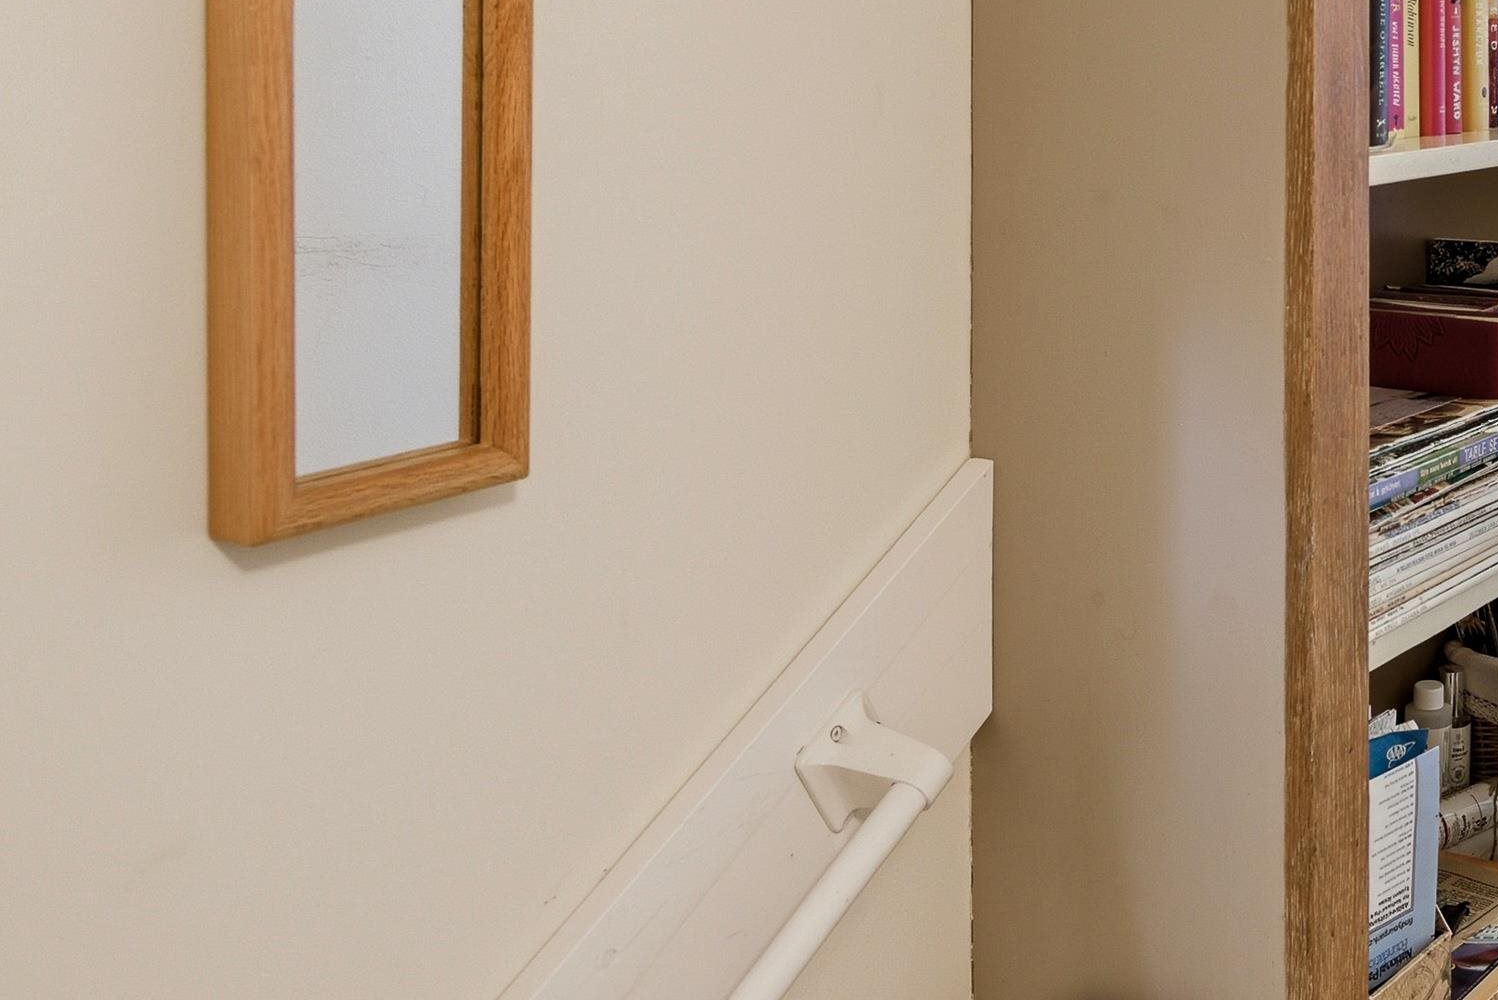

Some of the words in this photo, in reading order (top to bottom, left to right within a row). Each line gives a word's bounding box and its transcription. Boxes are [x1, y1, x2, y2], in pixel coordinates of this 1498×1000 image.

[1452, 24, 1461, 76] JESMYN
[1452, 81, 1461, 120] WARD
[1464, 444, 1488, 465] TABLE
[1379, 947, 1413, 974] National
